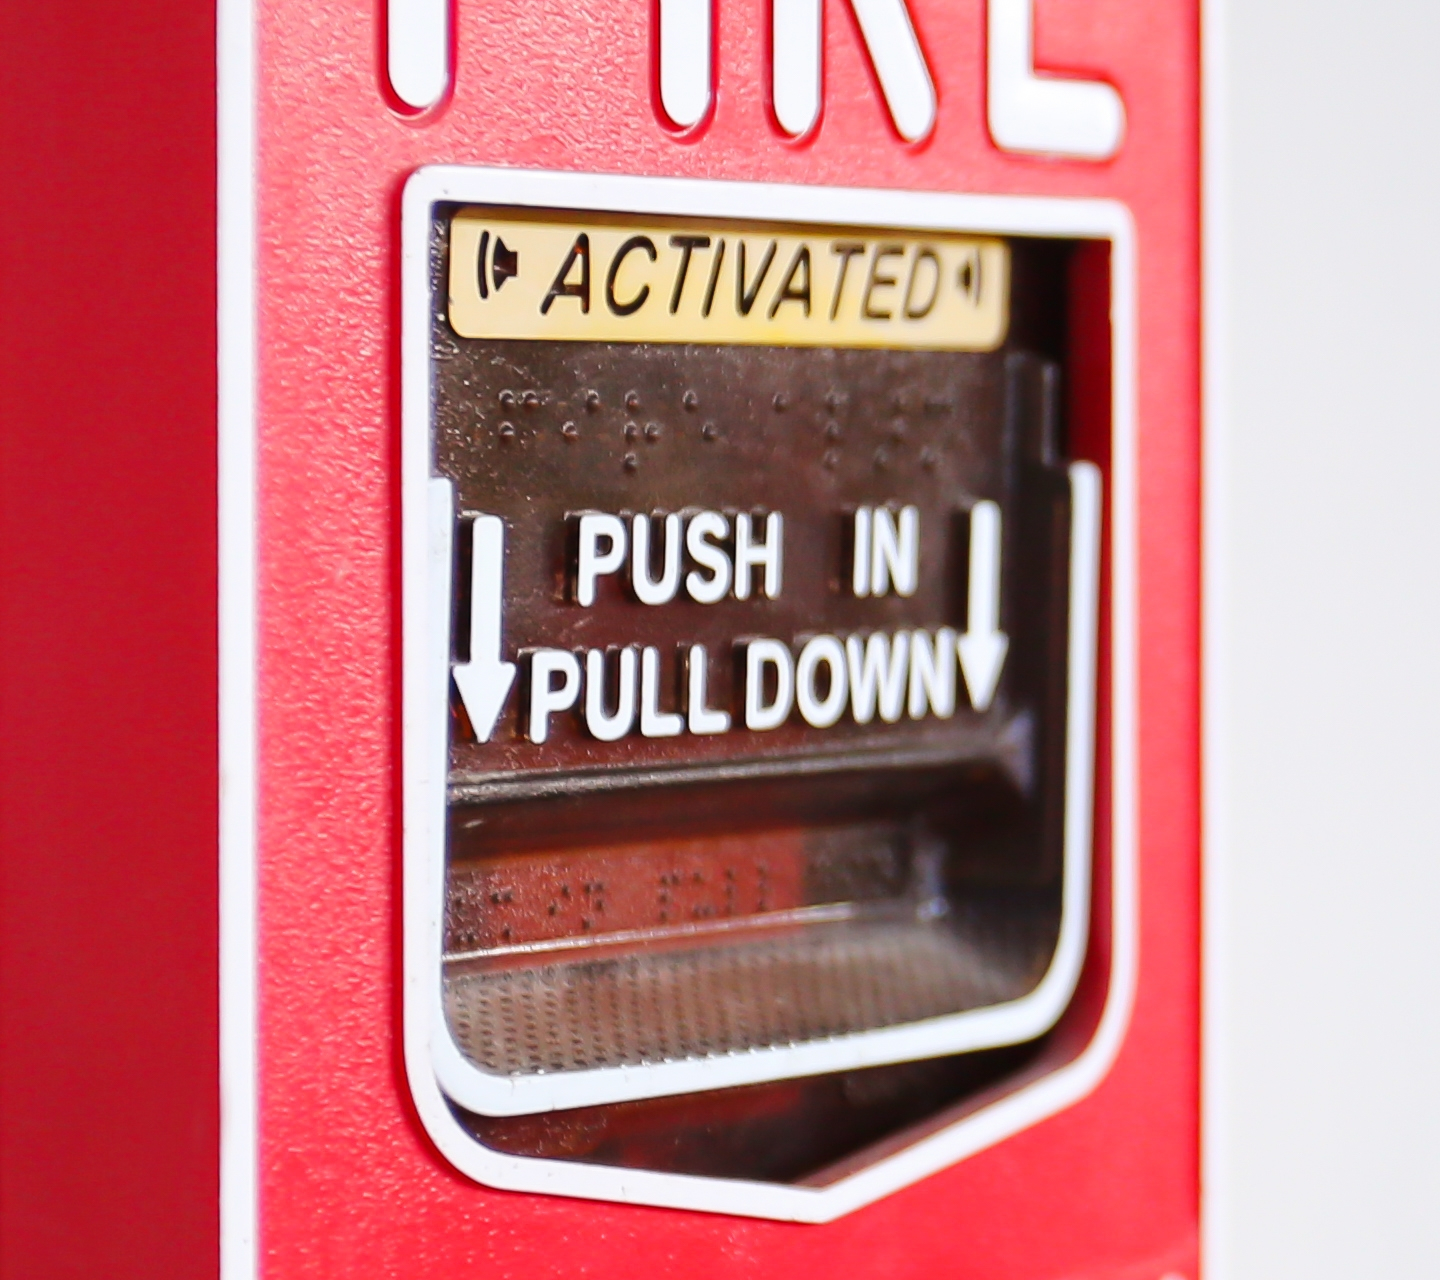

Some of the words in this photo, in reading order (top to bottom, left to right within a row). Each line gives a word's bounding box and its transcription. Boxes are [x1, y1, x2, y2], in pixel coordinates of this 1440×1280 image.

[539, 231, 943, 322] ACTIVATED
[576, 509, 784, 608] PUSH
[852, 504, 920, 599] IN
[528, 645, 731, 745] PULL
[744, 629, 957, 731] DOWN
